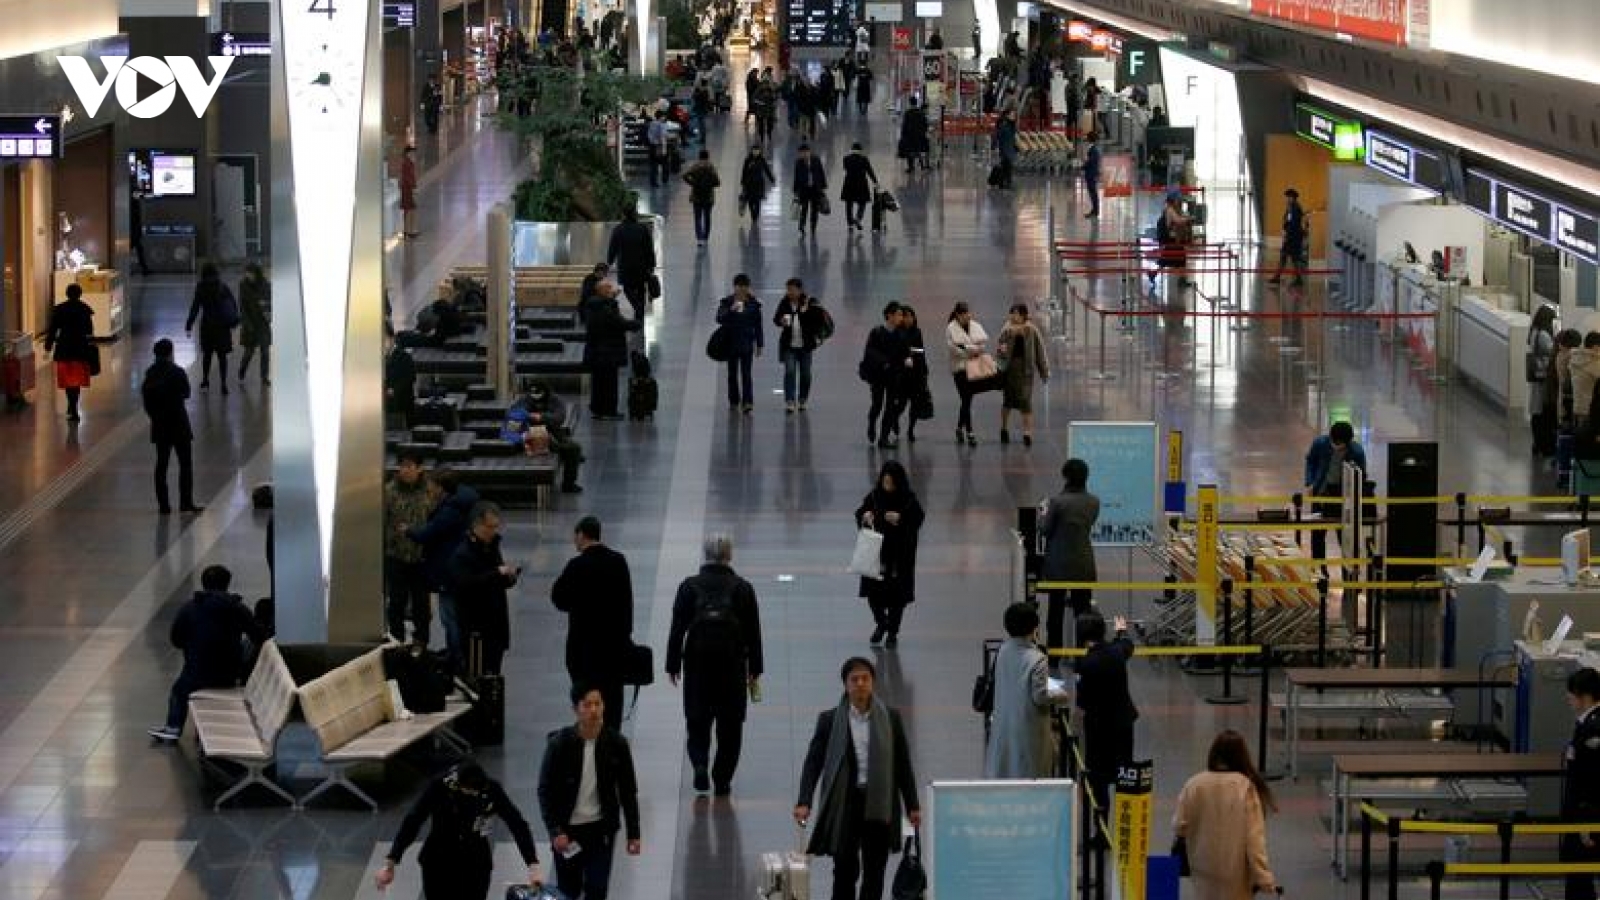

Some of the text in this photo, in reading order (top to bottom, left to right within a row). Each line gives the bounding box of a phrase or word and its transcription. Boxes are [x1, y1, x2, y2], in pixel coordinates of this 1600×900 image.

[307, 0, 337, 20] 4
[1129, 51, 1146, 75] F
[1187, 75, 1199, 95] F
[1117, 767, 1137, 780] 入口
